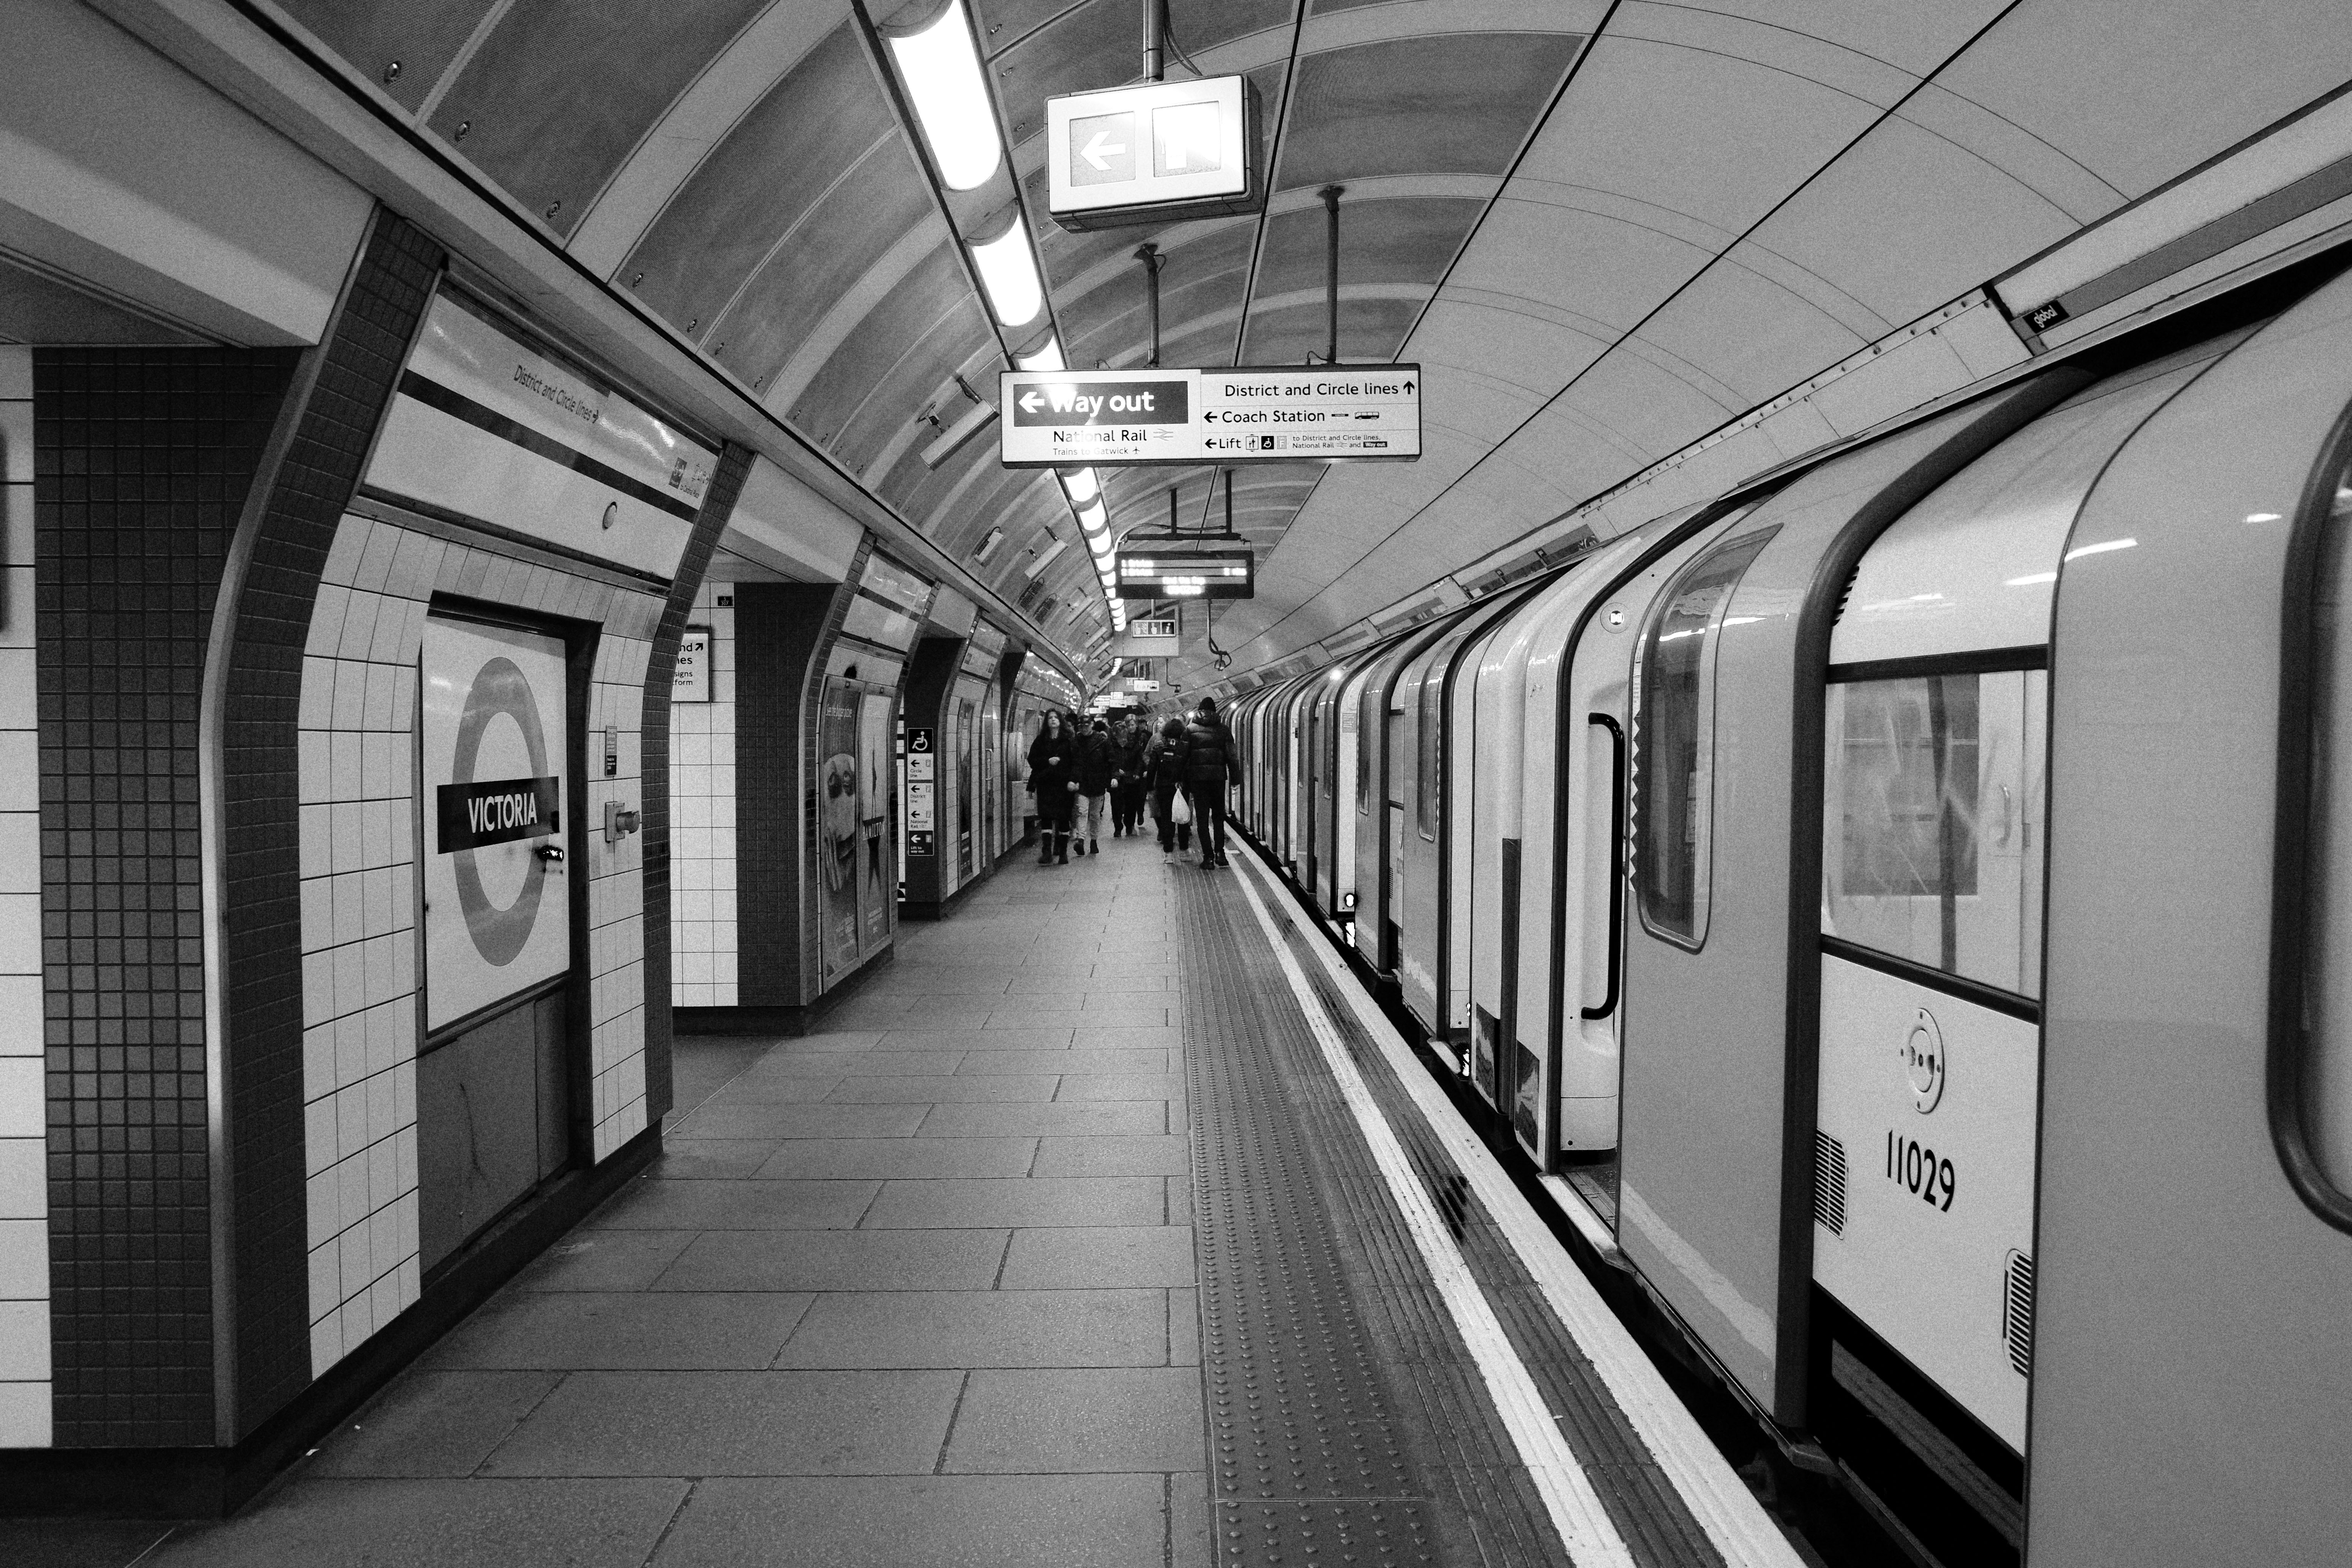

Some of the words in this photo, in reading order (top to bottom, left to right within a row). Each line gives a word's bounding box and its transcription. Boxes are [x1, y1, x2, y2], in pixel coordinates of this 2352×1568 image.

[2034, 305, 2058, 328] global
[514, 365, 542, 393] District
[542, 385, 558, 401] and
[556, 389, 576, 412] Circle
[575, 400, 592, 421] lines
[1225, 384, 1279, 396] District
[1285, 384, 1310, 395] and
[1317, 383, 1359, 395] Circle
[1365, 383, 1399, 394] lines
[1049, 391, 1104, 417] Way
[1110, 391, 1154, 412] out
[1222, 411, 1267, 423] Coach
[1273, 410, 1325, 422] Station
[1053, 430, 1115, 442] National
[1122, 429, 1147, 441] Rail
[1219, 438, 1241, 448] Lift
[680, 643, 692, 651] nd
[468, 792, 537, 833] VICTORIA
[862, 822, 885, 841] HAMILTON
[1887, 1129, 1955, 1212] 11029
